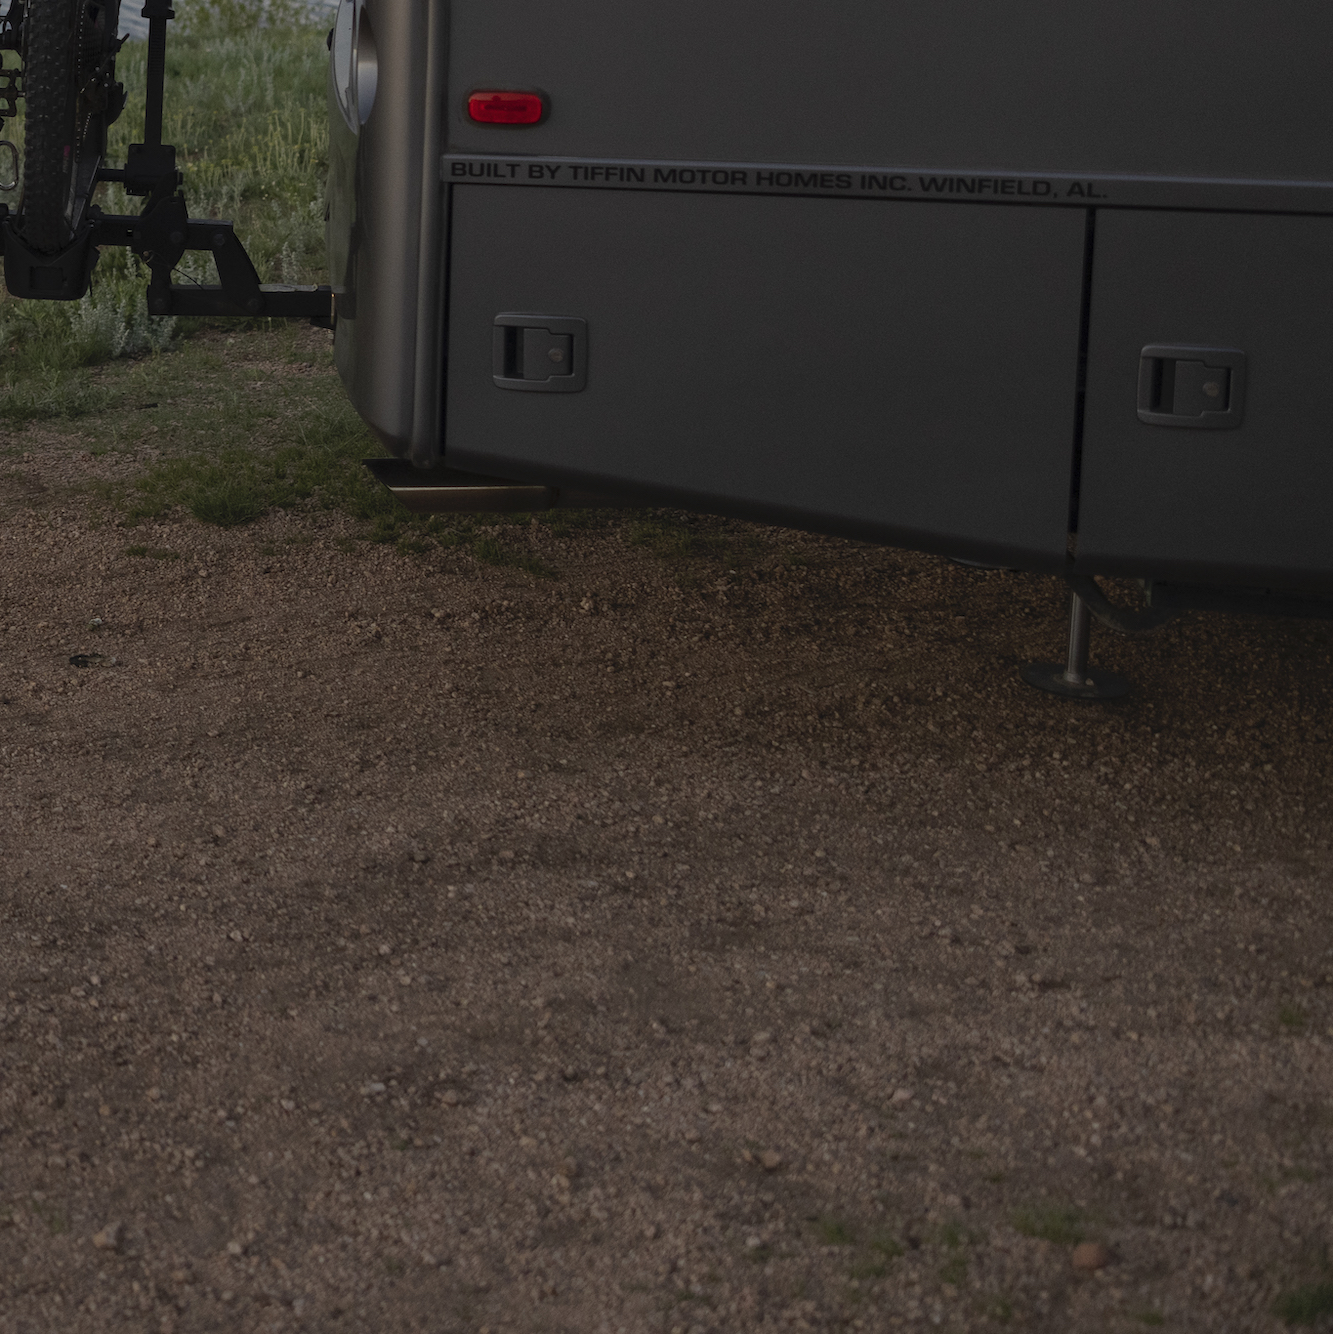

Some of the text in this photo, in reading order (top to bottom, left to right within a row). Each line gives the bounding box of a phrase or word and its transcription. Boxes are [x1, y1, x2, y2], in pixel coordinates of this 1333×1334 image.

[450, 162, 1108, 199] BUILT BY TIFFIN MOTOR HOMES INC. WINFIELD, AL.
